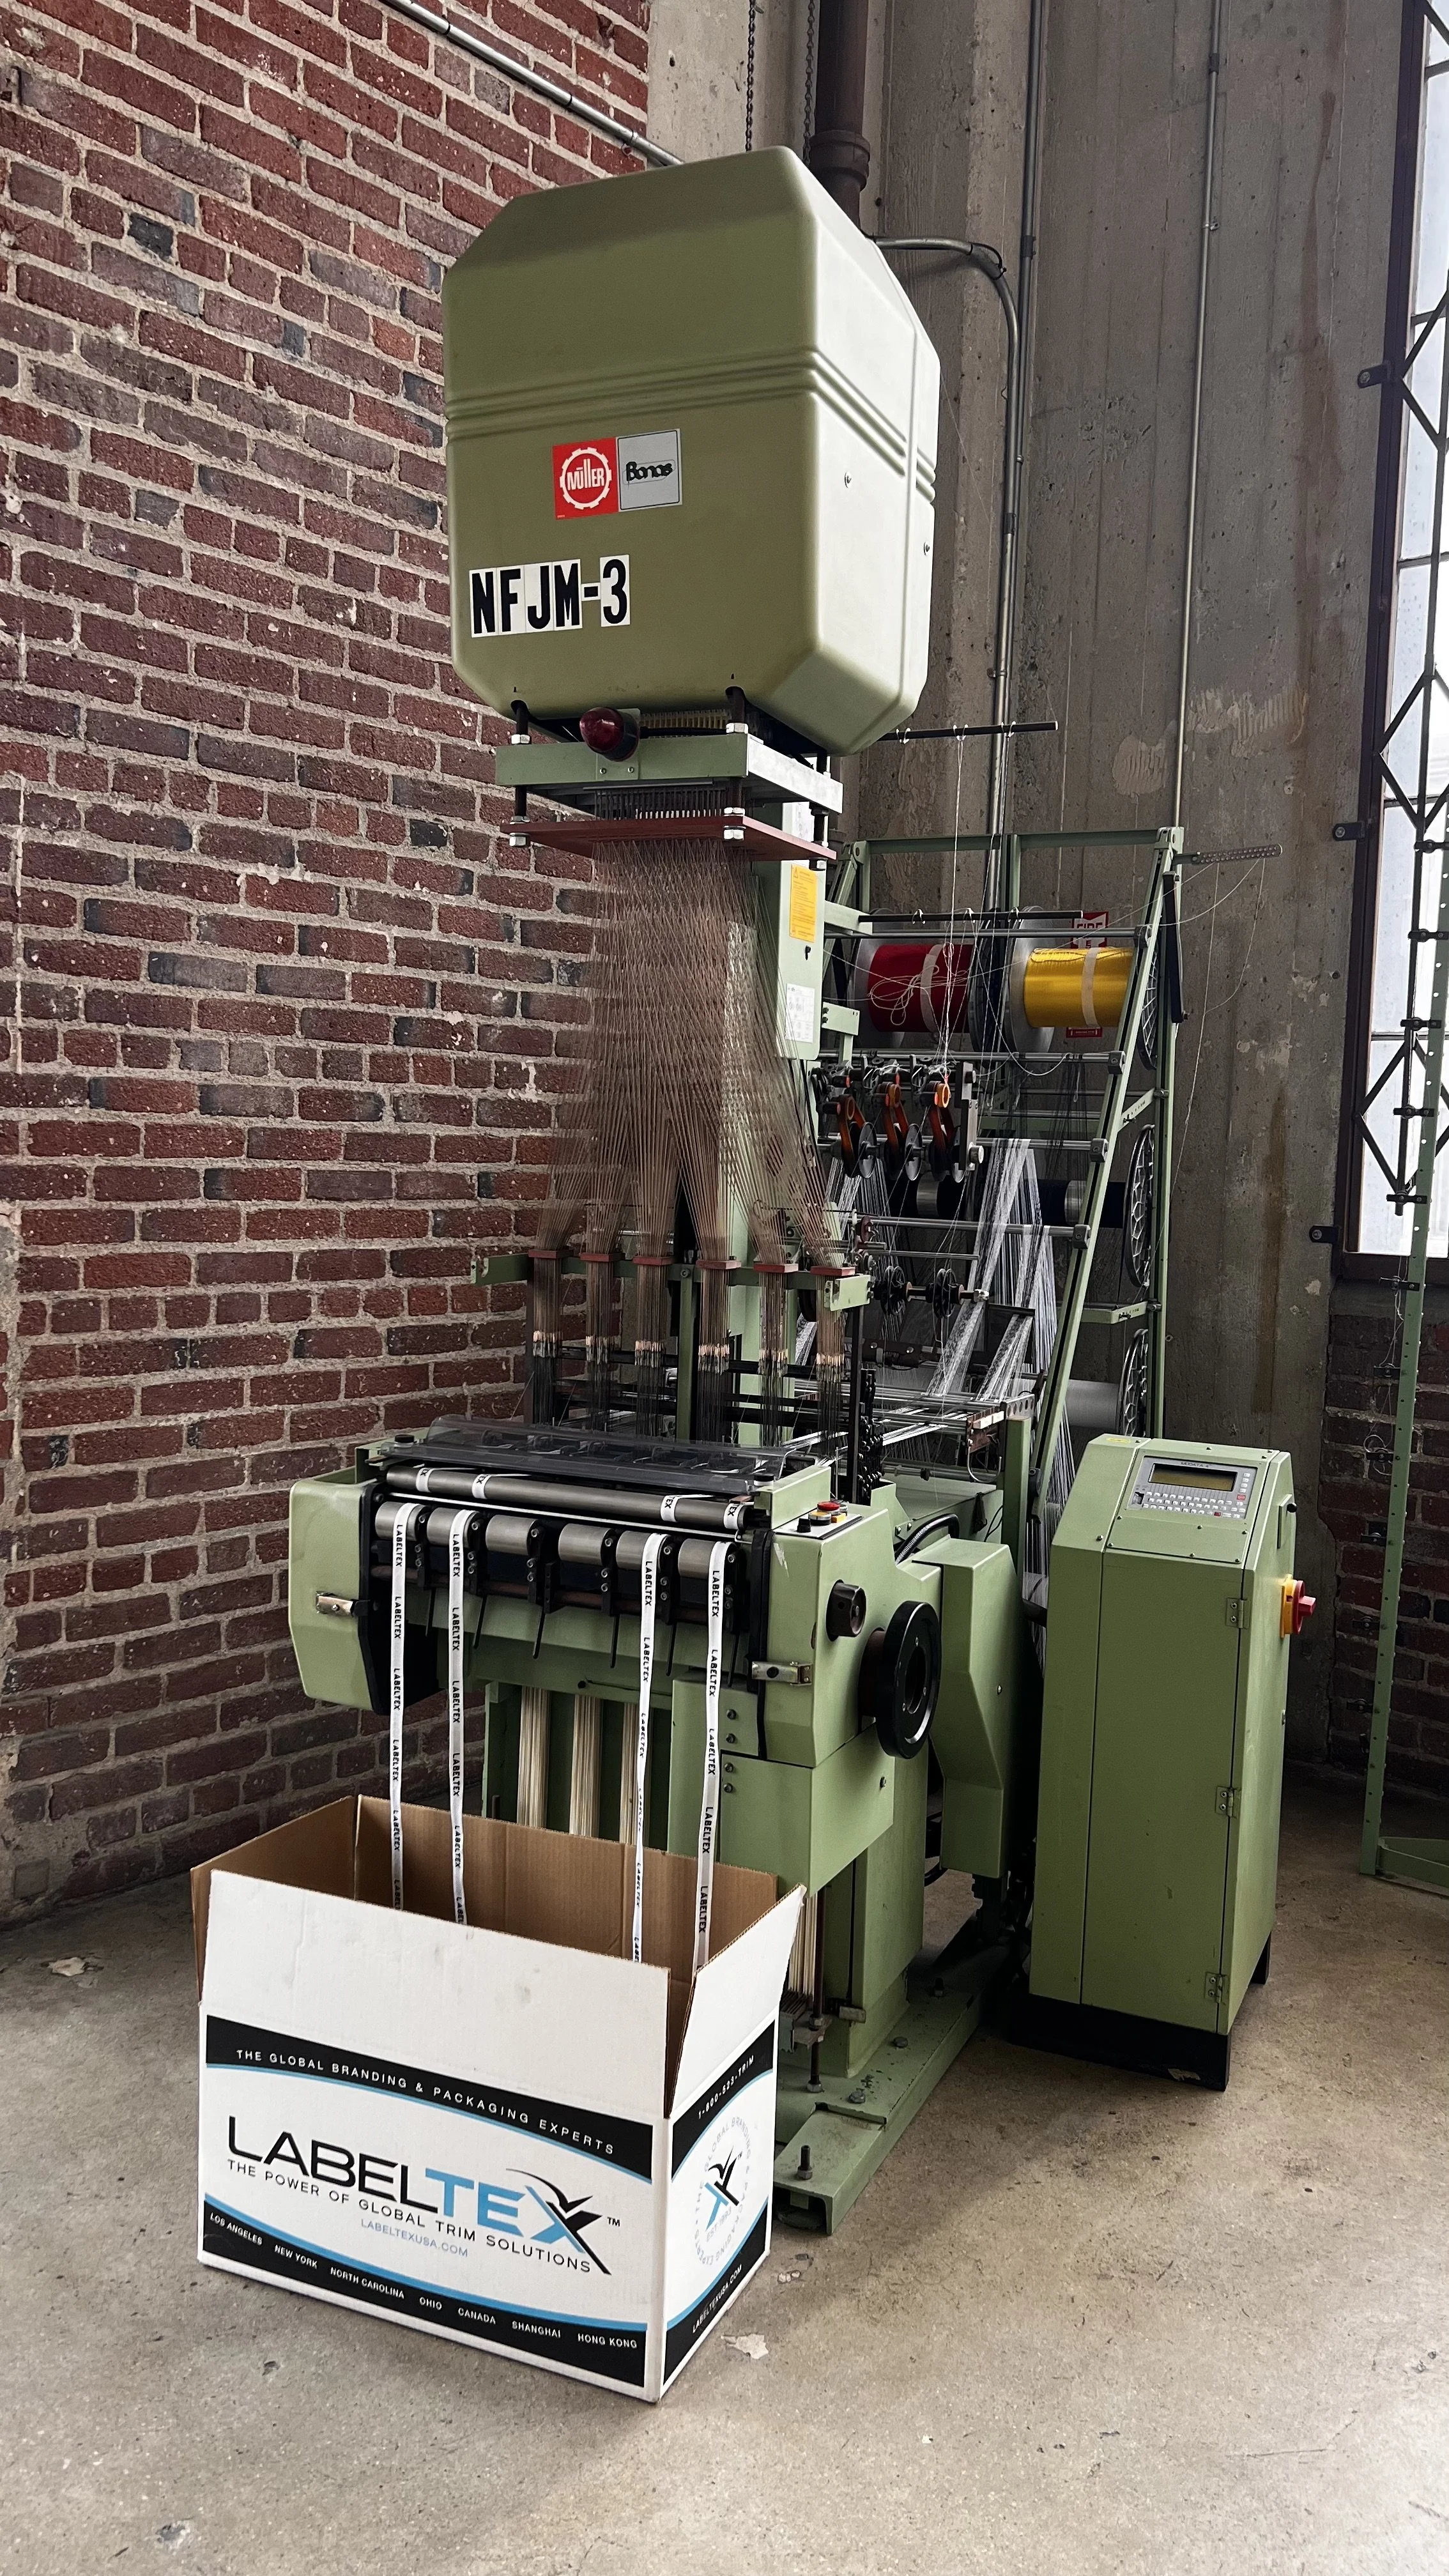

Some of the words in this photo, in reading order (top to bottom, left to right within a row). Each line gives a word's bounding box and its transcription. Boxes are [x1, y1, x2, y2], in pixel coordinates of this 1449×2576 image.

[625, 461, 673, 482] Bonas
[471, 558, 628, 635] NFJM-3
[712, 1570, 720, 1617] LABELTEX
[452, 1607, 460, 1651] LABELTEX
[709, 1650, 718, 1697] LABELTEX
[452, 1681, 460, 1723] LABELTEX
[702, 1807, 713, 1853] LABELTEX
[456, 1896, 464, 1923] LABEL
[698, 1885, 708, 1933] LABELTEX
[236, 2050, 262, 2062] THE
[270, 2053, 324, 2071] GLOBAL
[332, 2063, 407, 2089] BRANDING
[415, 2082, 424, 2092] &
[433, 2087, 528, 2124] PACKAGING
[539, 2119, 613, 2154] EXPERTS
[698, 2055, 754, 2119] 1-800-523-TRIM
[227, 2159, 256, 2177] THE
[265, 2171, 319, 2196] POWER
[329, 2190, 349, 2204] OF
[358, 2198, 425, 2227] GLOBAL
[435, 2220, 475, 2242] TRIM
[486, 2235, 591, 2273] SOLUTIONS
[229, 2115, 612, 2276] LABELTEX
[210, 2212, 225, 2227] LOS
[226, 2222, 263, 2246] ANGELES
[360, 2218, 468, 2257] LABELTEXUSA.COM
[274, 2244, 293, 2258] NEW
[295, 2253, 318, 2269] YORK
[330, 2267, 359, 2284] NORTH
[362, 2278, 405, 2299] CAROLINA
[419, 2297, 442, 2310] OHIO
[693, 2264, 742, 2334] LABELTEXUSA.COM
[457, 2307, 496, 2325] CANADA
[512, 2320, 561, 2338] SHANGHAI
[578, 2333, 606, 2345] HONG
[609, 2337, 638, 2349] KONG
